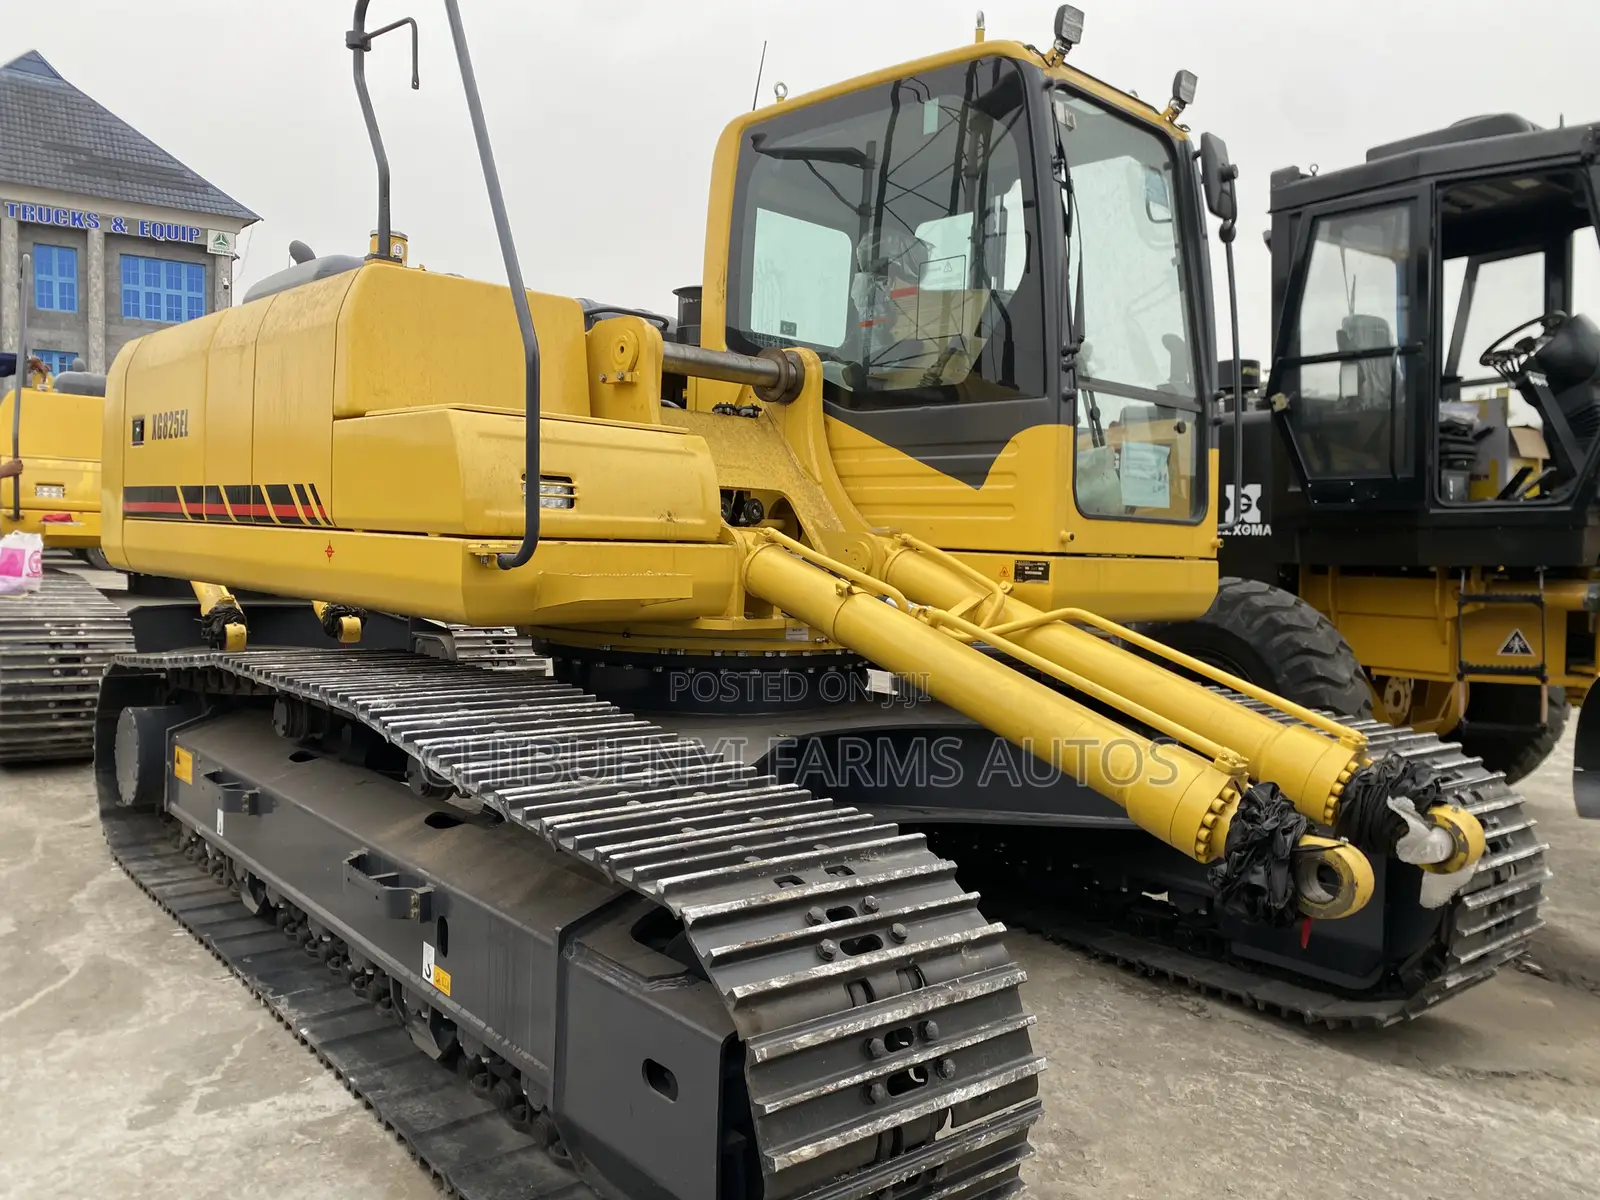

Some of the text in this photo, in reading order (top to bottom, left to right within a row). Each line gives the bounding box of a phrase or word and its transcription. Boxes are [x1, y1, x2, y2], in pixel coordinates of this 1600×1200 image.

[4, 202, 200, 243] TRUCKS & EQUIP
[1232, 523, 1272, 536] XGMA
